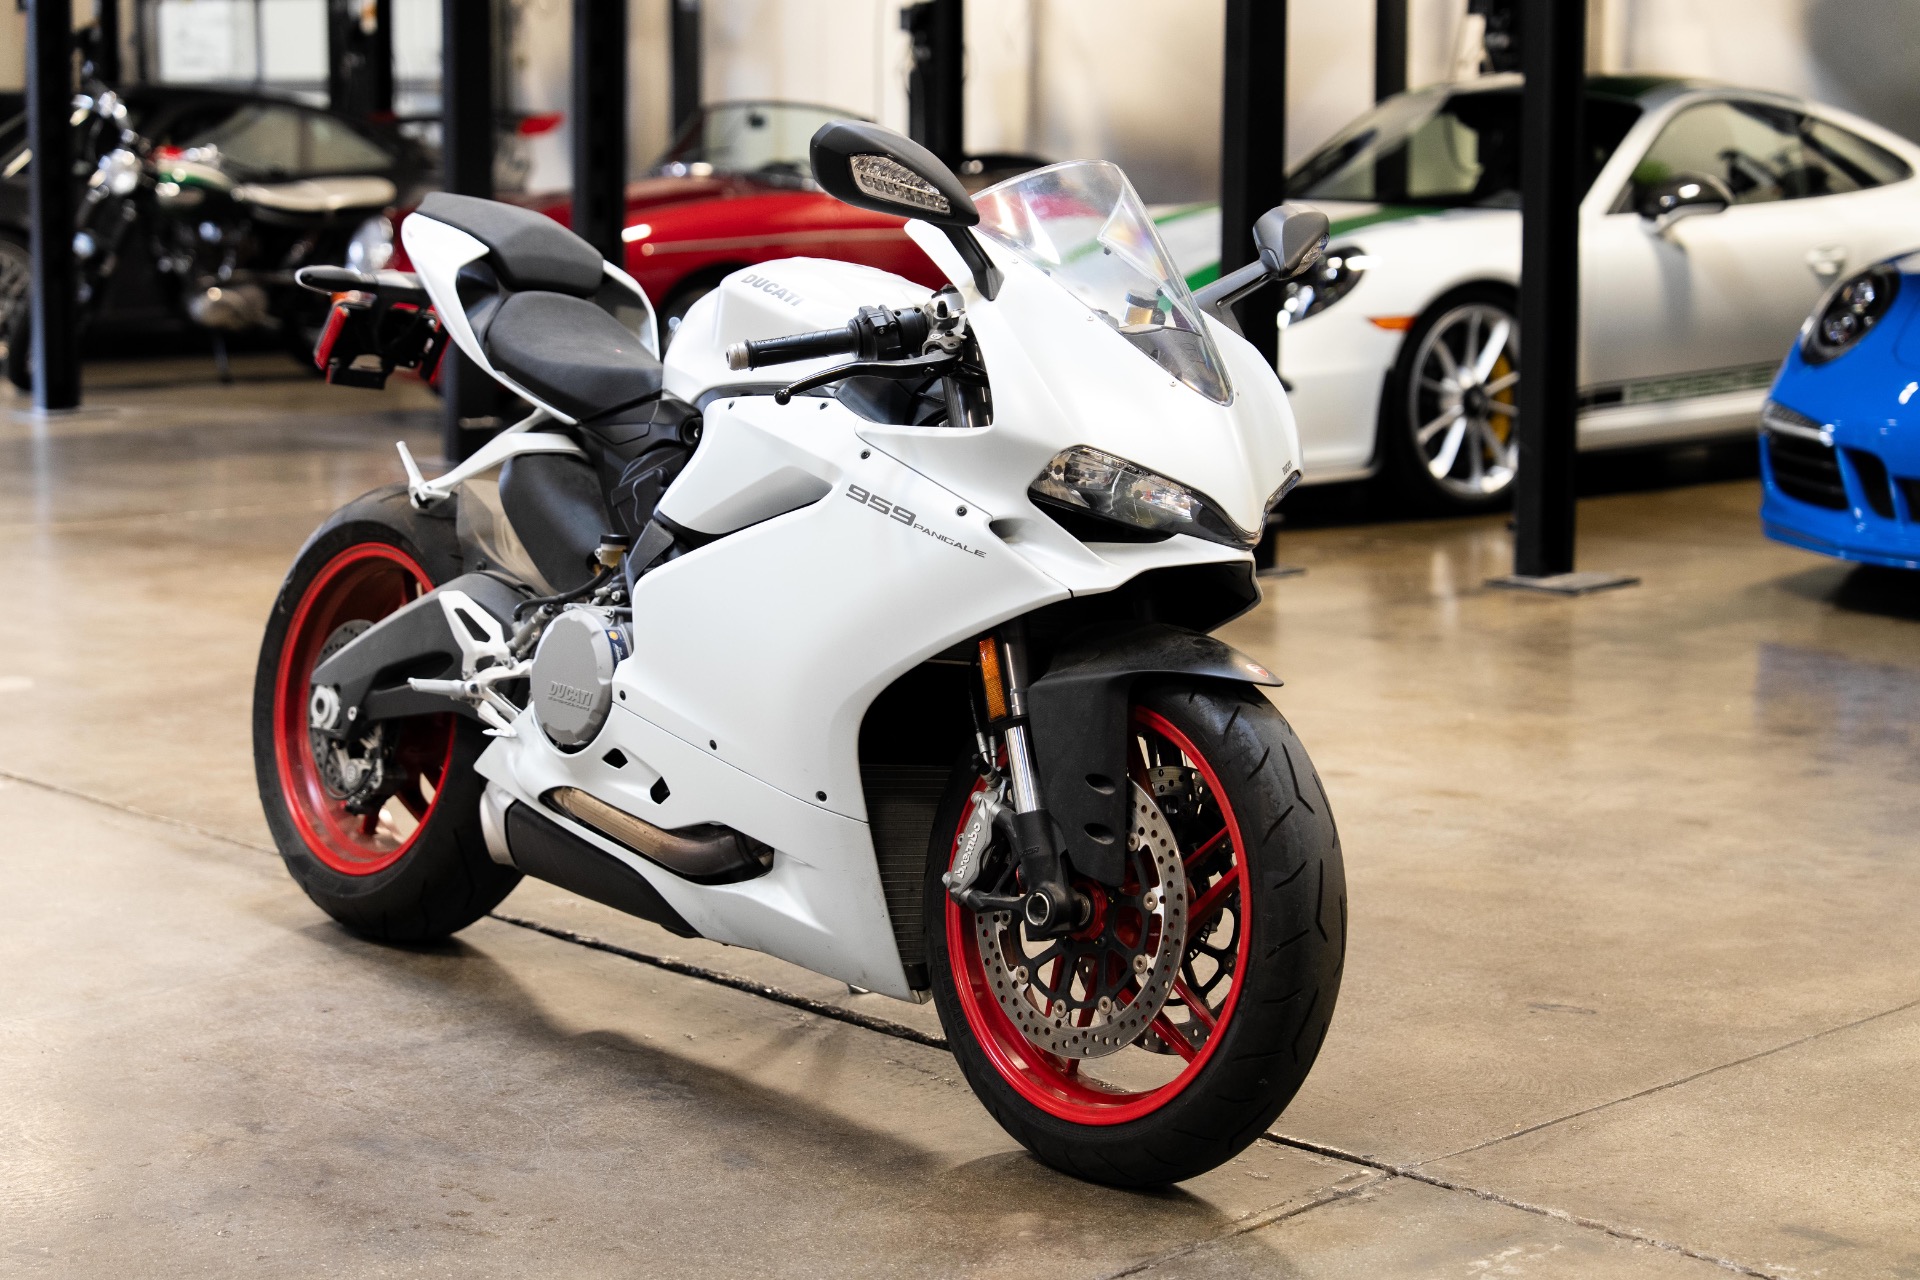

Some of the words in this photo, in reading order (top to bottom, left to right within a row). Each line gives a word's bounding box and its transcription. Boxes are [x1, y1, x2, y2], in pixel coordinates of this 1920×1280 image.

[740, 273, 804, 307] DUCATI
[845, 483, 917, 527] 959
[912, 523, 987, 559] PANIGALE
[550, 681, 593, 706] DUCATI
[954, 821, 982, 879] brembo
